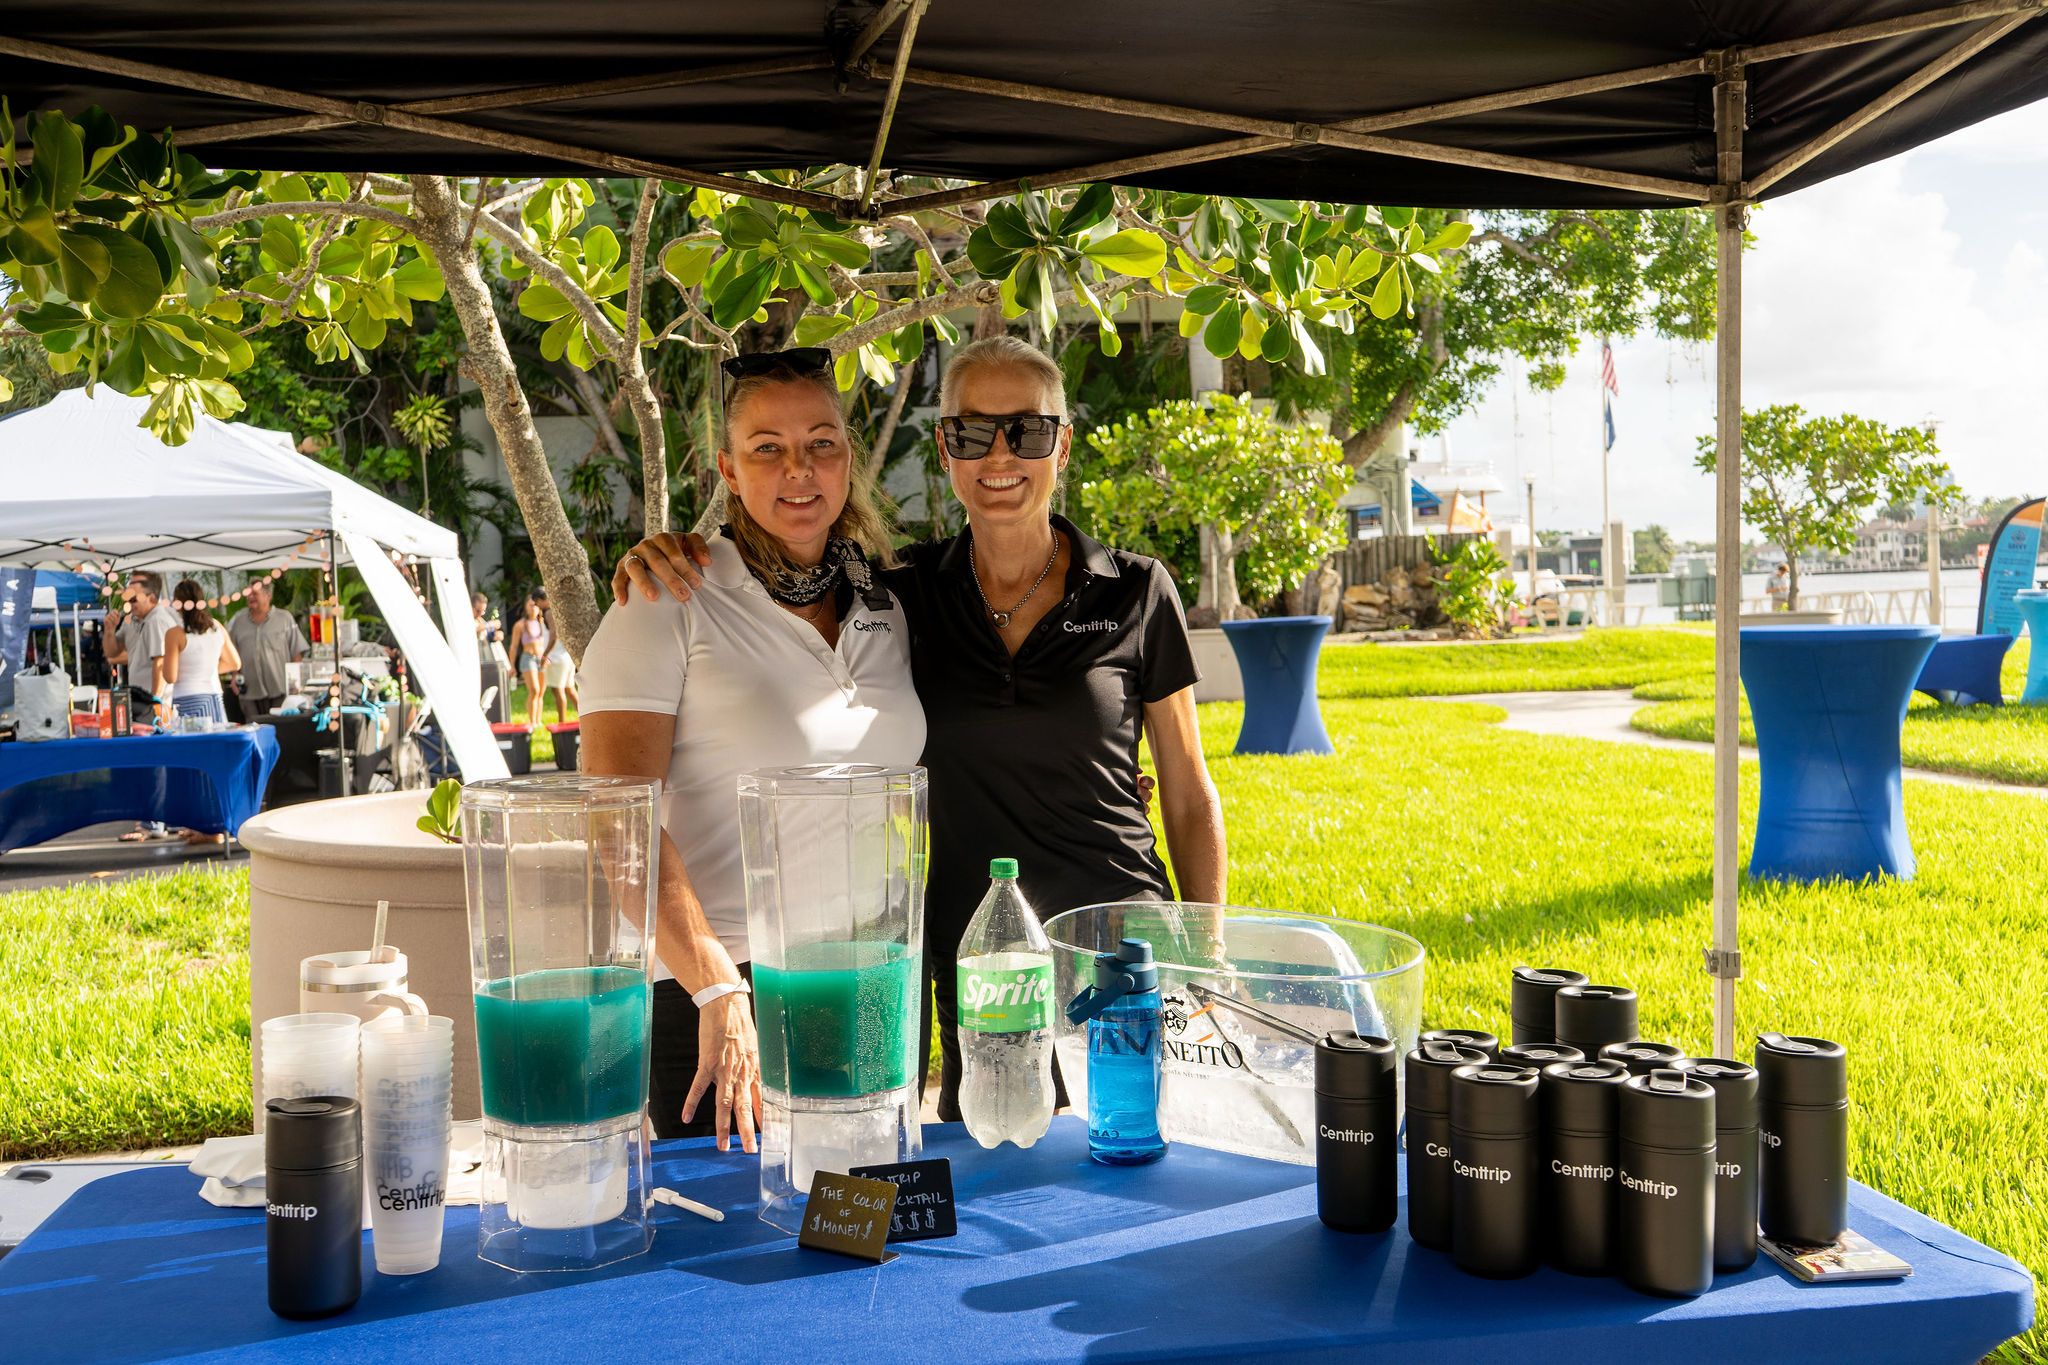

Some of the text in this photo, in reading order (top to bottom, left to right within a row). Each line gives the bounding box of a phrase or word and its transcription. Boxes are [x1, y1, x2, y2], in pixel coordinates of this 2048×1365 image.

[1063, 619, 1118, 634] Centtrip
[963, 973, 1049, 1012] Sprite
[1320, 1124, 1375, 1145] Centtrip
[1425, 1142, 1451, 1158] Ce
[1453, 1160, 1512, 1184] Centtrip
[1551, 1159, 1615, 1181] Centtrip
[1619, 1170, 1678, 1199] Centtrip
[265, 1198, 318, 1221] Centtrip
[379, 1189, 445, 1211] Centtrip
[820, 1186, 887, 1213] THE COLOR
[839, 1208, 851, 1217] OF
[822, 1219, 861, 1240] MONEY
